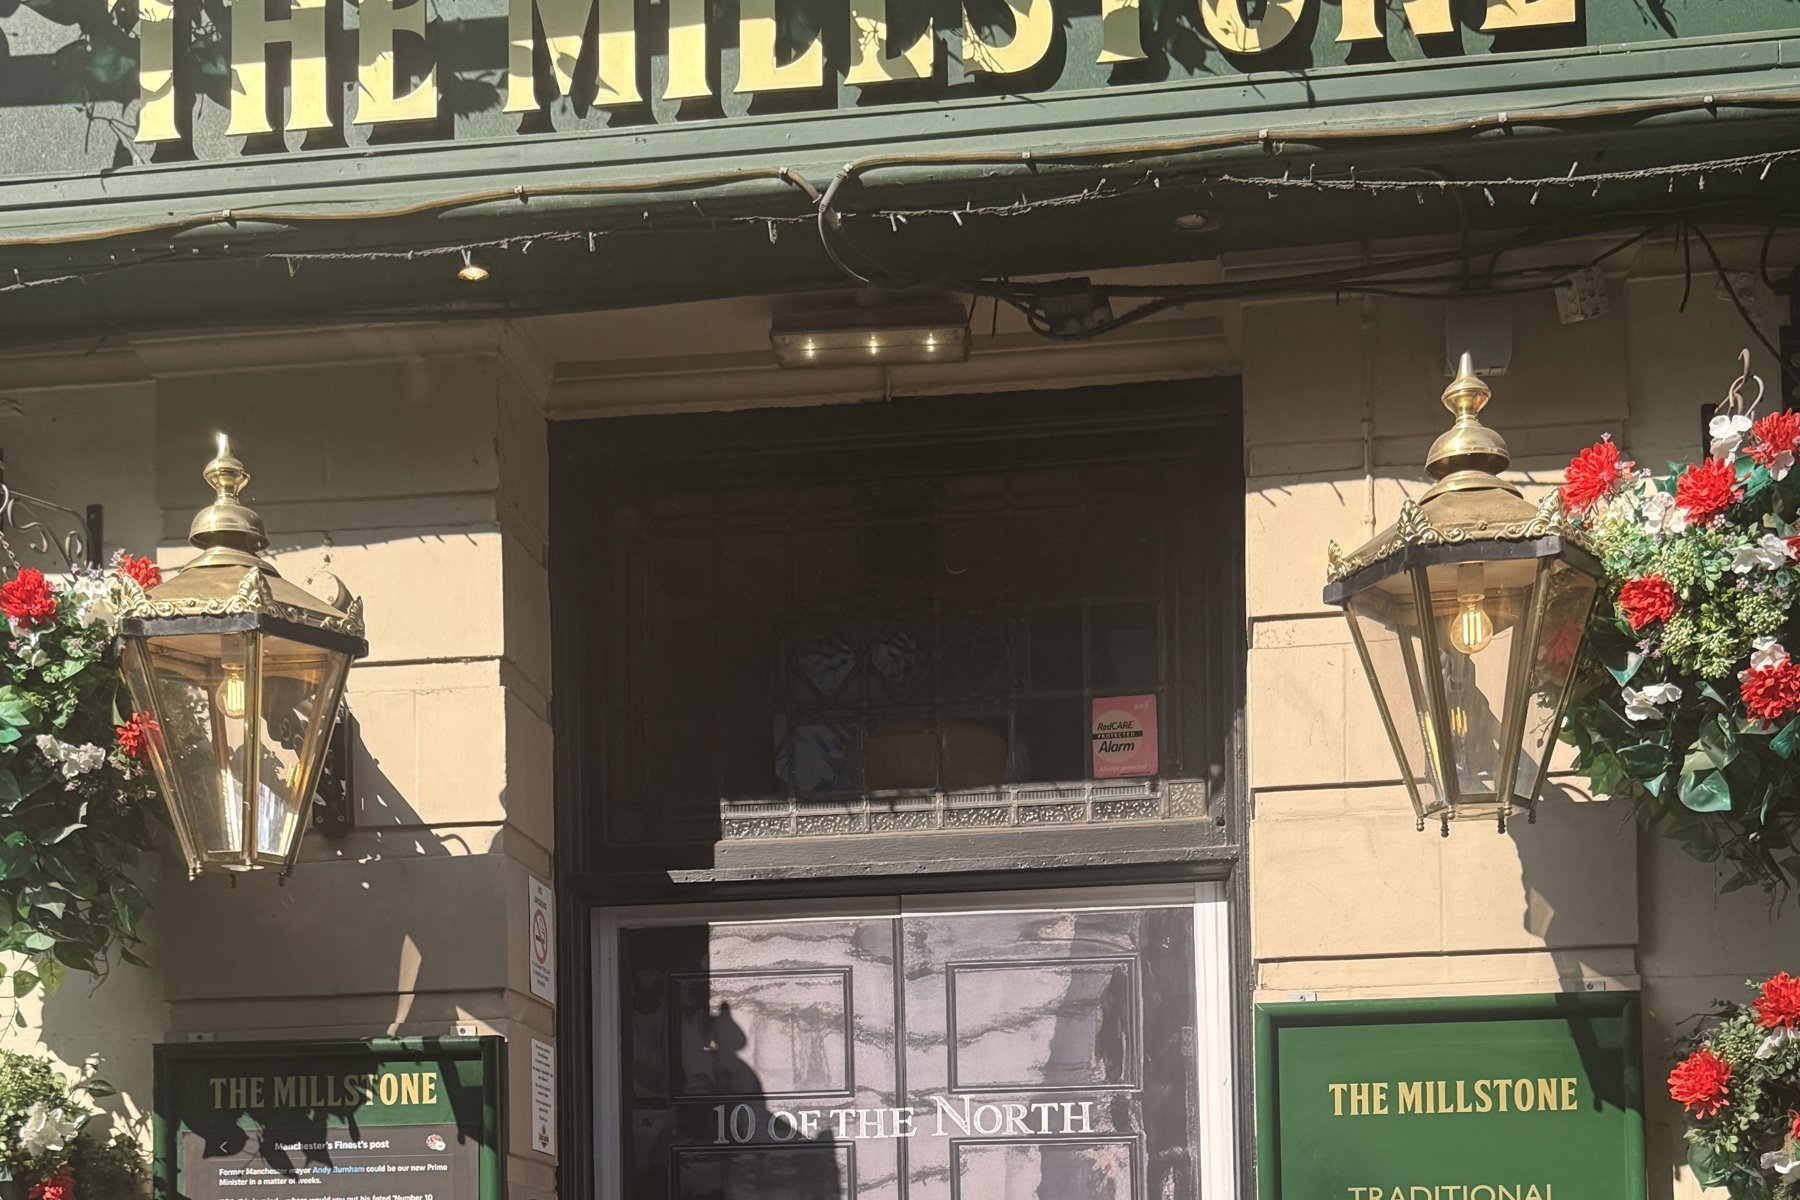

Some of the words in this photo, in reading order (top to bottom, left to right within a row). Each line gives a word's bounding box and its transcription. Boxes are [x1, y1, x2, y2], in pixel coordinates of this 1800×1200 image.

[1098, 740, 1135, 753] Alarm
[209, 1077, 265, 1109] THE
[273, 1072, 437, 1108] MILLSTONE
[1328, 1081, 1389, 1116] THE
[1398, 1077, 1578, 1115] MILLSTONE
[713, 1103, 757, 1144] 10
[768, 1109, 821, 1141] OF
[829, 1106, 917, 1139] THE
[929, 1095, 1096, 1137] NORTH
[275, 1141, 333, 1150] Manchester's
[335, 1141, 368, 1150] Finest's
[369, 1140, 390, 1151] post
[219, 1168, 244, 1176] Former
[245, 1167, 288, 1175] Manchester
[289, 1168, 311, 1176] mayor
[313, 1166, 331, 1175] Andy
[366, 1164, 386, 1172] could
[387, 1164, 396, 1172] be
[427, 1163, 448, 1171] Prime
[219, 1178, 248, 1186] Minister
